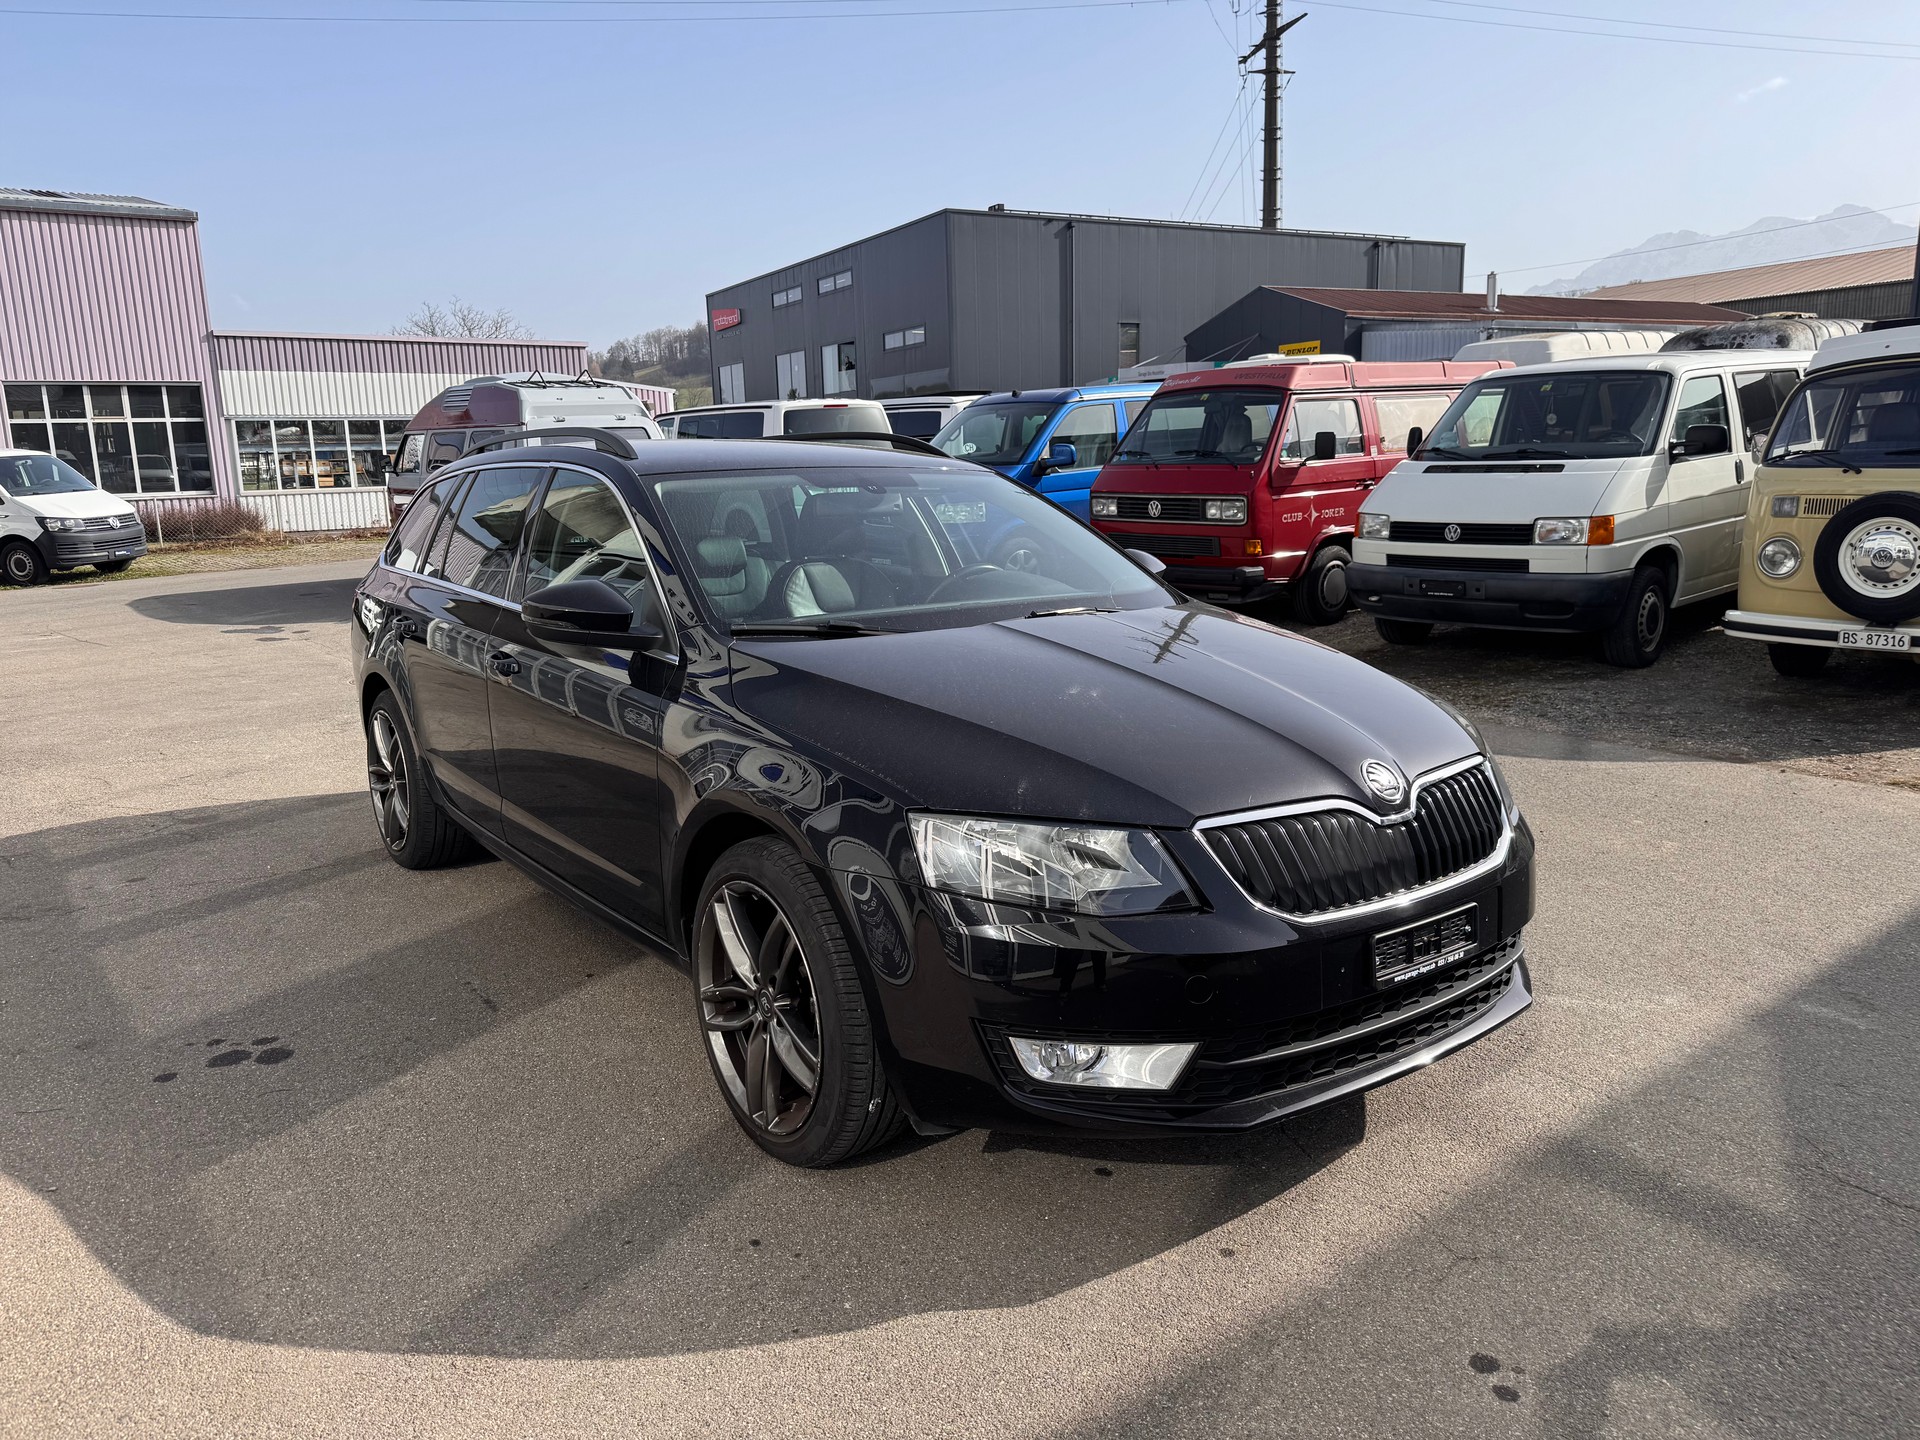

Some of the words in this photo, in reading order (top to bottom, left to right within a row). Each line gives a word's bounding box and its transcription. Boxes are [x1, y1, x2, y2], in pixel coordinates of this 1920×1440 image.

[1286, 346, 1318, 356] DUNLOP
[1234, 371, 1288, 381] WESTFALIA
[964, 444, 974, 452] CH
[1281, 512, 1303, 523] CLUB
[1320, 507, 1345, 519] JOKER
[1842, 632, 1858, 645] BS
[1865, 633, 1905, 648] 87316
